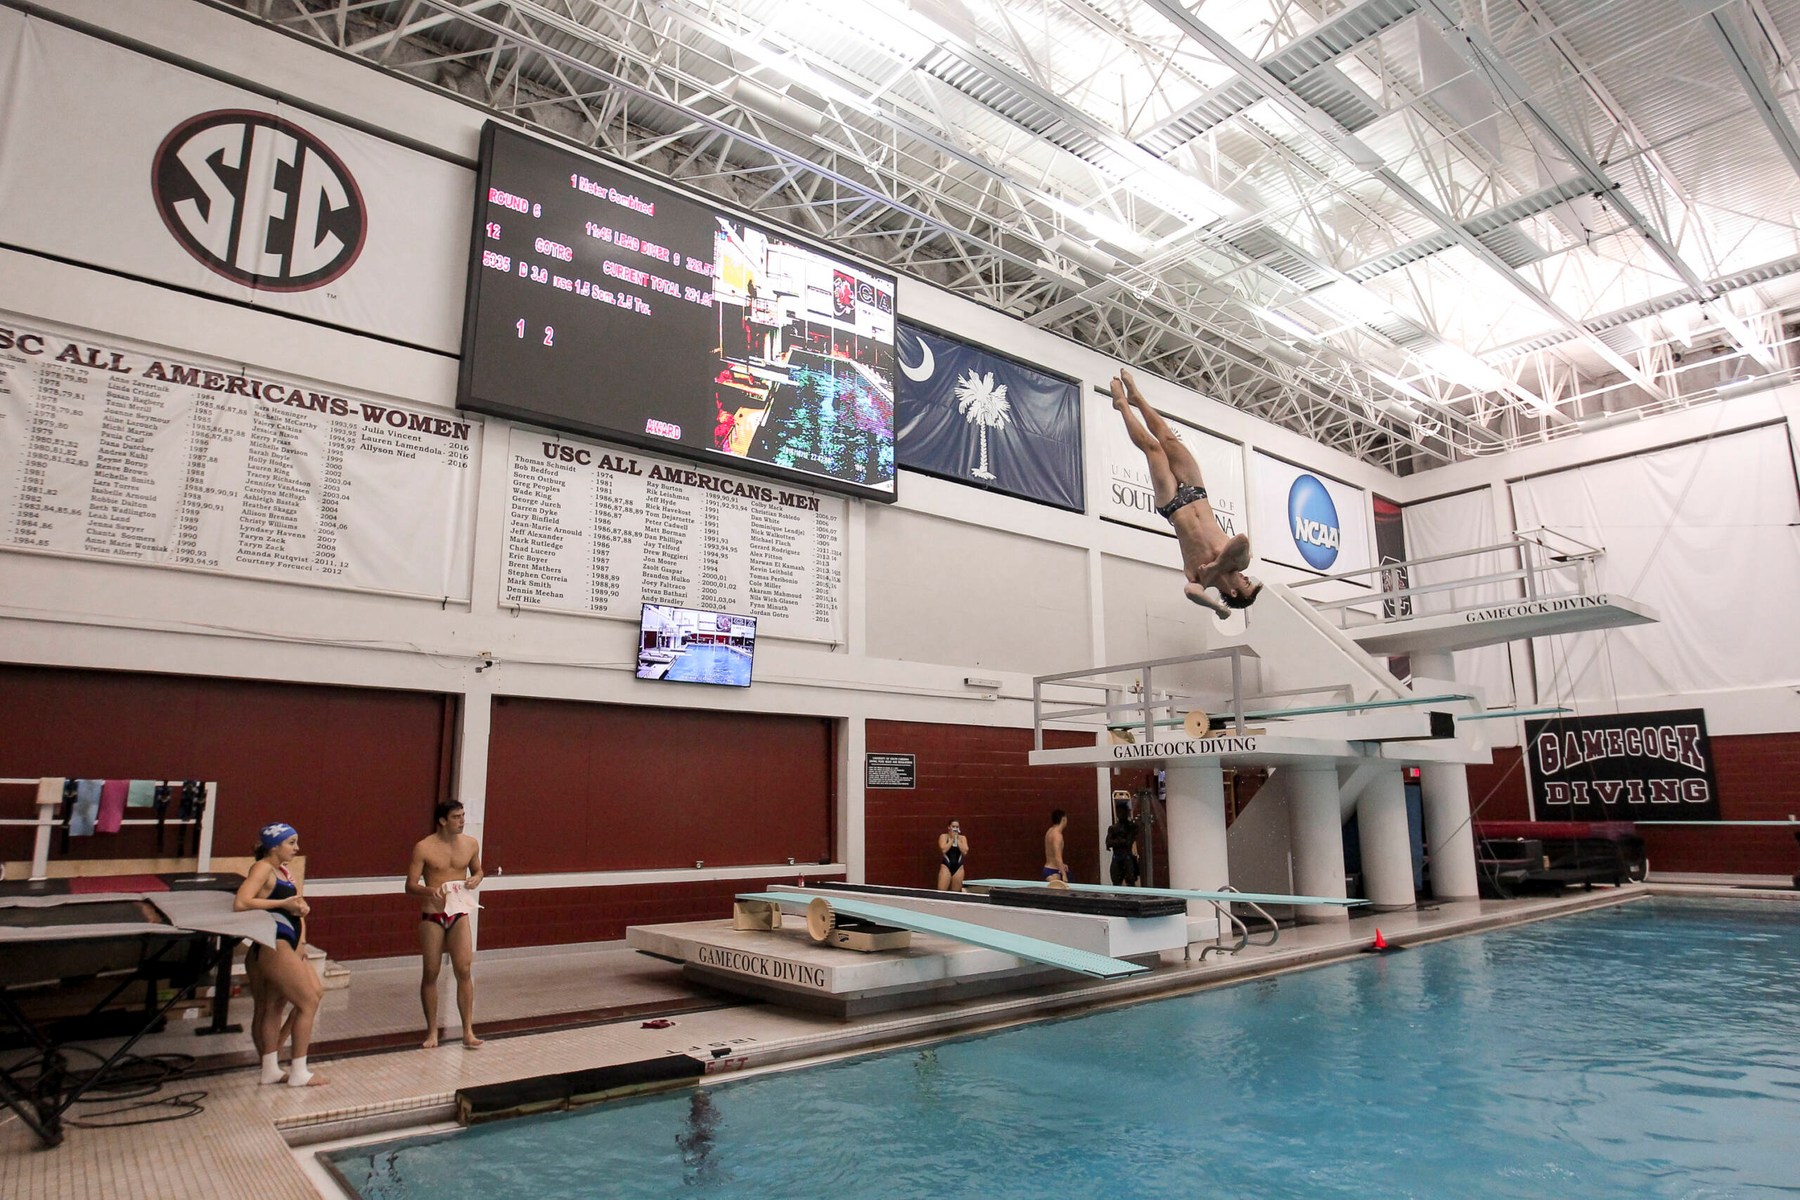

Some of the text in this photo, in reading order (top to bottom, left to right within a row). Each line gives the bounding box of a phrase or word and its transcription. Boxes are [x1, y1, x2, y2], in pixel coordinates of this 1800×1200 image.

[173, 123, 350, 278] SEC
[489, 187, 542, 218] ROUND 6
[570, 174, 654, 216] 1 Meter Combined
[486, 222, 501, 239] 12
[614, 230, 639, 251] LEAD
[640, 240, 670, 262] DIVER
[483, 250, 511, 272] 5335
[519, 262, 528, 278] D
[574, 279, 590, 296] 1.5
[592, 284, 616, 305] Som.
[617, 293, 634, 309] 2.5
[603, 260, 649, 288] CURRENT
[651, 275, 681, 298] TOTAL
[516, 319, 554, 346] 1 2
[56, 343, 132, 373] ALL
[143, 361, 470, 440] AMERICANS-WOMEN
[362, 425, 470, 452] Julia Vincent 2016
[646, 419, 681, 440] AWARD
[360, 443, 468, 469] Allyson Nied 2016
[361, 433, 392, 446] Lauren
[448, 451, 469, 461] 2016
[514, 463, 612, 487] Bob Bedford 1981
[515, 455, 614, 480] Thomas Schmidt 1974
[542, 442, 820, 512] USC ALL AMERICANS-MEN
[513, 471, 535, 481] Soren
[596, 486, 612, 495] 1981
[513, 479, 531, 489] Greg
[533, 482, 560, 492] Peoples
[646, 480, 660, 489] Ray
[661, 483, 683, 493] Burton
[512, 495, 539, 506] George
[513, 487, 532, 496] Wade
[535, 491, 552, 501] King
[1112, 484, 1157, 514] SOUT
[512, 503, 612, 525] Darren Dyke 1986
[645, 503, 660, 511] Rick
[662, 505, 691, 516] Havekost
[660, 498, 676, 506] Hyde
[705, 506, 719, 514] 1991
[1219, 499, 1234, 510] OF
[511, 511, 529, 521] Gary
[645, 518, 662, 526] Peter
[239, 524, 337, 544] Lyndsey Havens 2007
[511, 520, 552, 532] Jean-Marie
[554, 526, 582, 536] Arnould
[1296, 517, 1340, 550] NCAA
[238, 540, 263, 549] Taryn
[265, 543, 285, 552] Zack
[239, 532, 336, 552] Taryn Zack 2008
[510, 536, 610, 556] Mark Rutledge 1987
[527, 530, 564, 542] Alexander
[593, 540, 610, 549] 1986
[237, 548, 272, 558] Amanda
[274, 553, 308, 563] Rutqvist
[509, 544, 529, 552] Chad
[530, 547, 556, 556] Lucero
[236, 556, 342, 575] Courtney Forcucci 2012
[508, 552, 609, 572] Eric Boyer 1987
[508, 560, 529, 569] Brent
[531, 564, 561, 574] Mathers
[507, 577, 527, 586] Mark
[528, 580, 552, 589] Smith
[508, 569, 539, 579] Stephen
[506, 594, 522, 602] Jeff
[523, 596, 541, 604] Hike
[507, 585, 533, 595] Dennis
[1466, 595, 1608, 623] GAMECOCK DIVING
[1113, 737, 1257, 759] GAMECOCK DIVING
[1537, 724, 1706, 775] GAMECOCK
[1545, 778, 1710, 804] DIVING
[699, 946, 825, 987] GAMECOCK DIVING
[722, 1058, 748, 1071] FT
